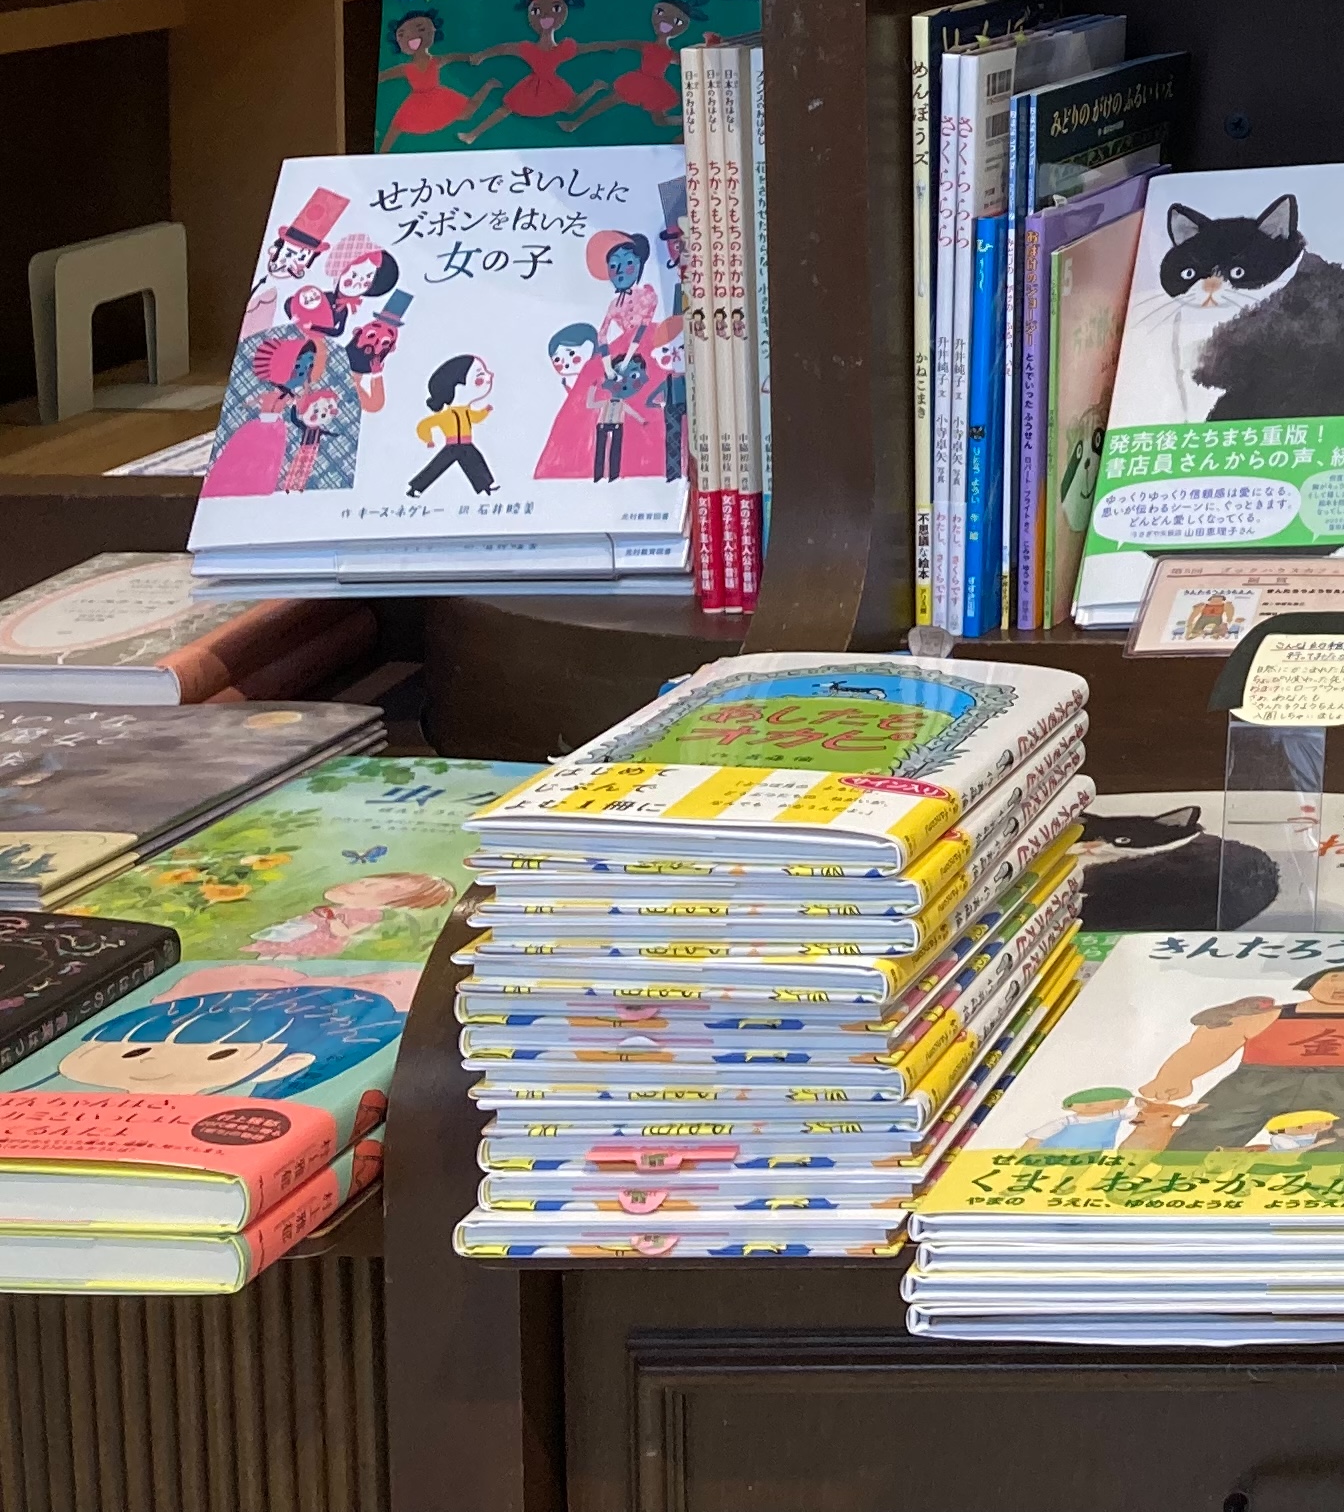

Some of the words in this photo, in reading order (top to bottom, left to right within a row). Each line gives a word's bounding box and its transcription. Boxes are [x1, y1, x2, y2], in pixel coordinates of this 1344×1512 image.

[912, 61, 929, 166] めんぼうズ
[390, 205, 589, 246] ズボンをはいた
[422, 241, 554, 283] 女の子
[686, 160, 706, 299] ちからもちのおかね
[708, 160, 727, 298] ちからもちのおかね
[725, 160, 745, 299] ちからもちのおかね
